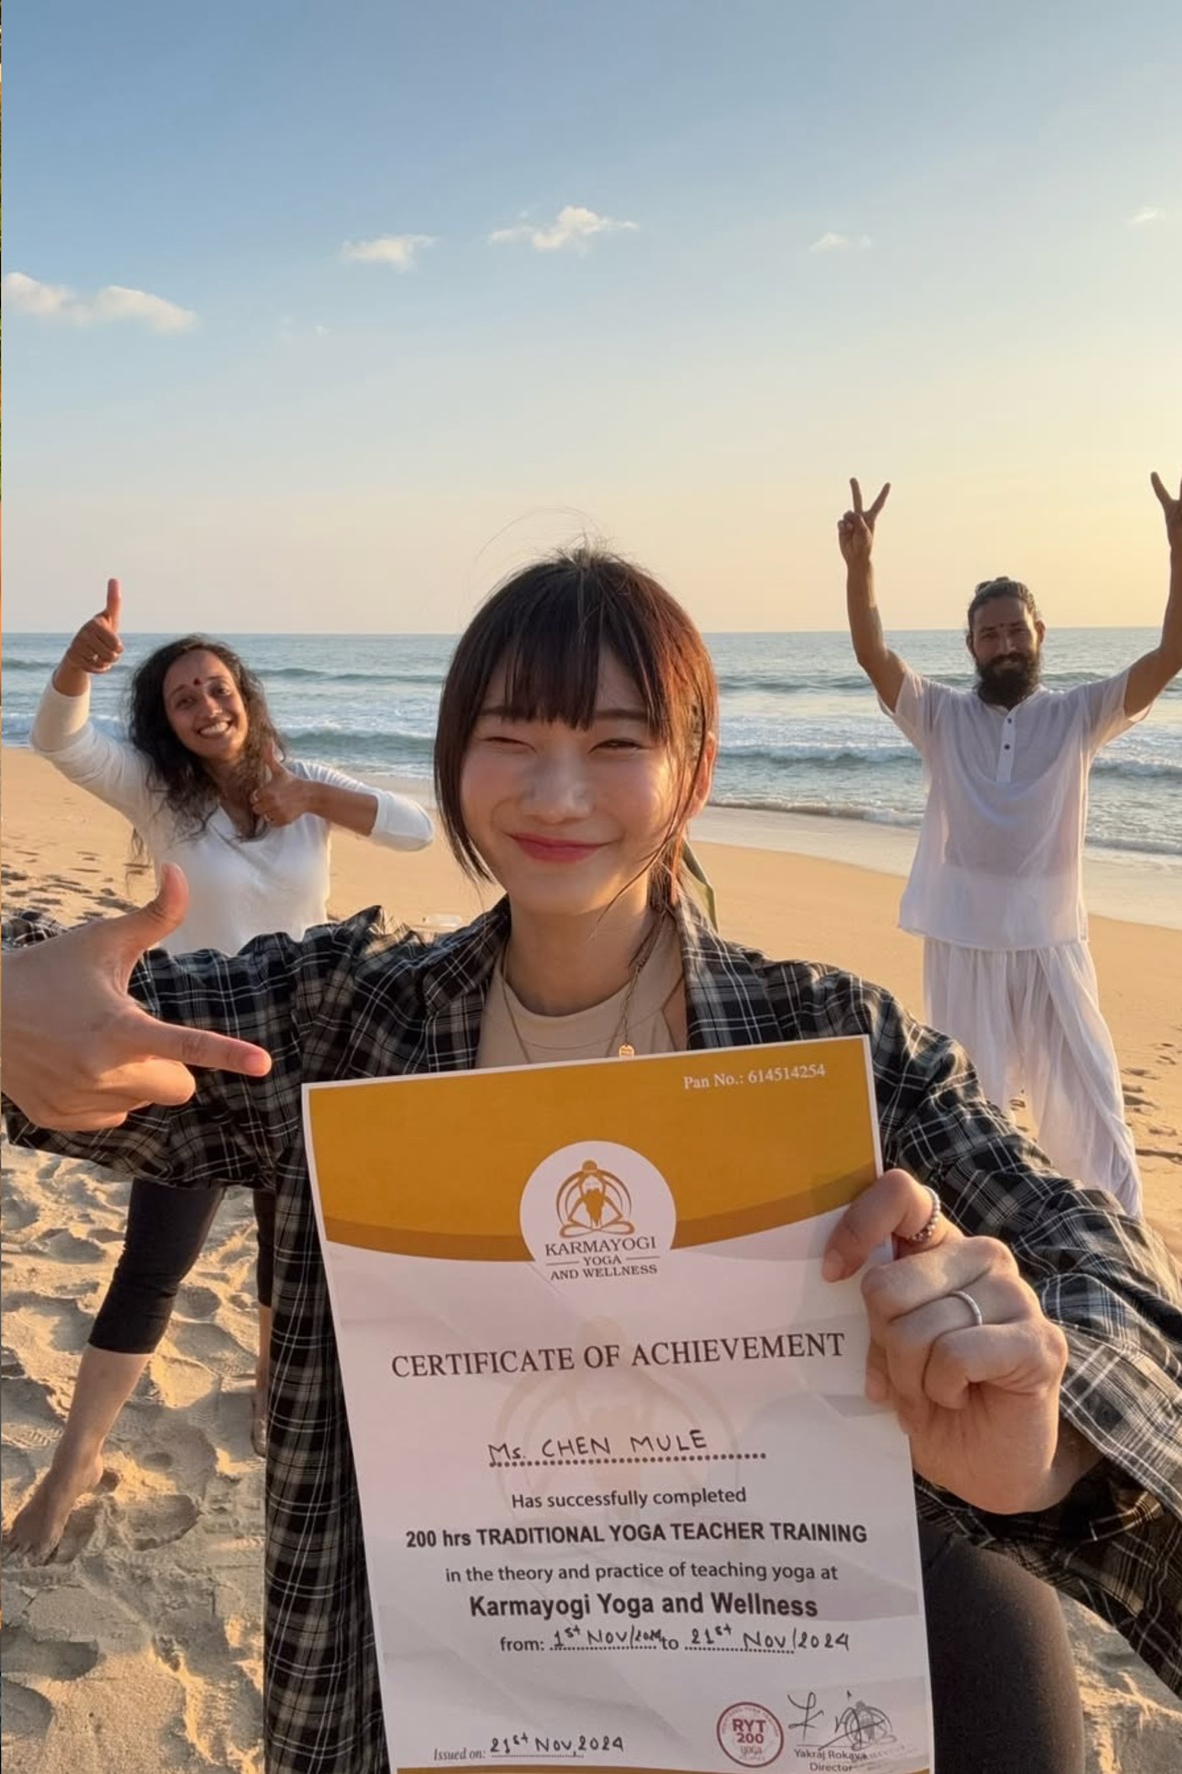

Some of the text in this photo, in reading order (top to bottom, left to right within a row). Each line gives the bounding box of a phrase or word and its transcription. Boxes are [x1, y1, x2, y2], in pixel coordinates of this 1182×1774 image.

[684, 1063, 827, 1089] Pan No.: 614514254
[545, 1236, 657, 1257] KARMAYOGI
[583, 1254, 622, 1266] YOGA
[550, 1264, 658, 1280] AND WELLNESS
[391, 1332, 846, 1378] CERTIFICATE OF ACHIEVEMENT
[487, 1428, 707, 1460] Ms. CHEN MULE
[511, 1486, 747, 1509] Has successfully completed
[405, 1522, 868, 1548] 200 hrs TRADITIONAL YOGA TEACHER TRAINING
[445, 1561, 839, 1584] in the theory and practice of teaching yoga at
[469, 1592, 819, 1621] Karmayogi Yoga and Wellness
[500, 1636, 545, 1651] from:
[661, 1638, 679, 1650] to
[691, 1623, 733, 1645] 21st
[732, 1718, 767, 1733] RYT
[736, 1732, 765, 1744] 200
[434, 1748, 466, 1761] Issued
[469, 1748, 485, 1760] on:
[809, 1762, 852, 1772] Director
